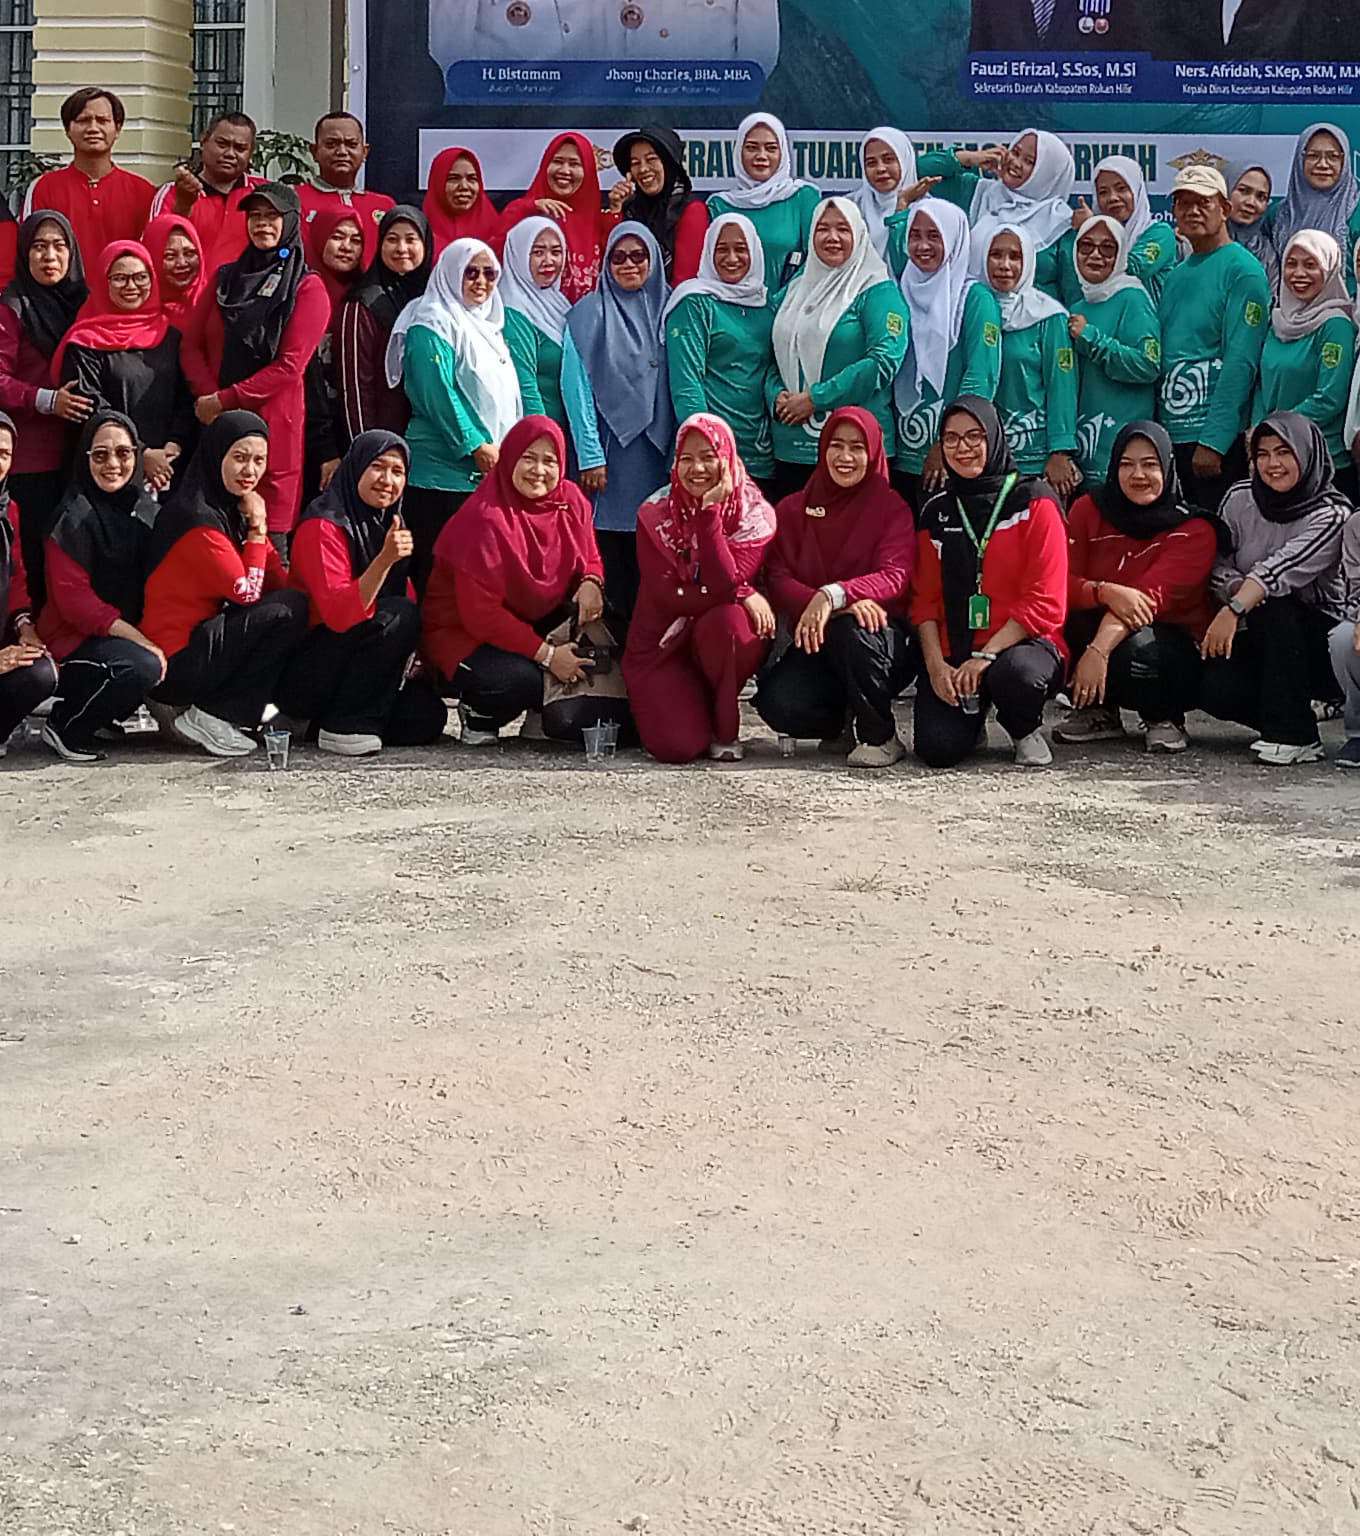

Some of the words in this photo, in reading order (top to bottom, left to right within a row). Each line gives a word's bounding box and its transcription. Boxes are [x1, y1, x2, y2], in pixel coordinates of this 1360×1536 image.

[498, 66, 561, 81] Bistamam
[606, 68, 642, 83] Jhony
[971, 62, 1008, 76] Fauzi
[1011, 62, 1059, 78] Efrizal,
[1062, 62, 1102, 78] S.Sos,
[1106, 62, 1136, 77] M.Si
[1175, 65, 1209, 78] Ners.
[1211, 64, 1262, 79] Afridah,
[1264, 65, 1302, 81] S.Kep,
[1305, 65, 1337, 79] SKM,
[793, 141, 863, 179] TUAH
